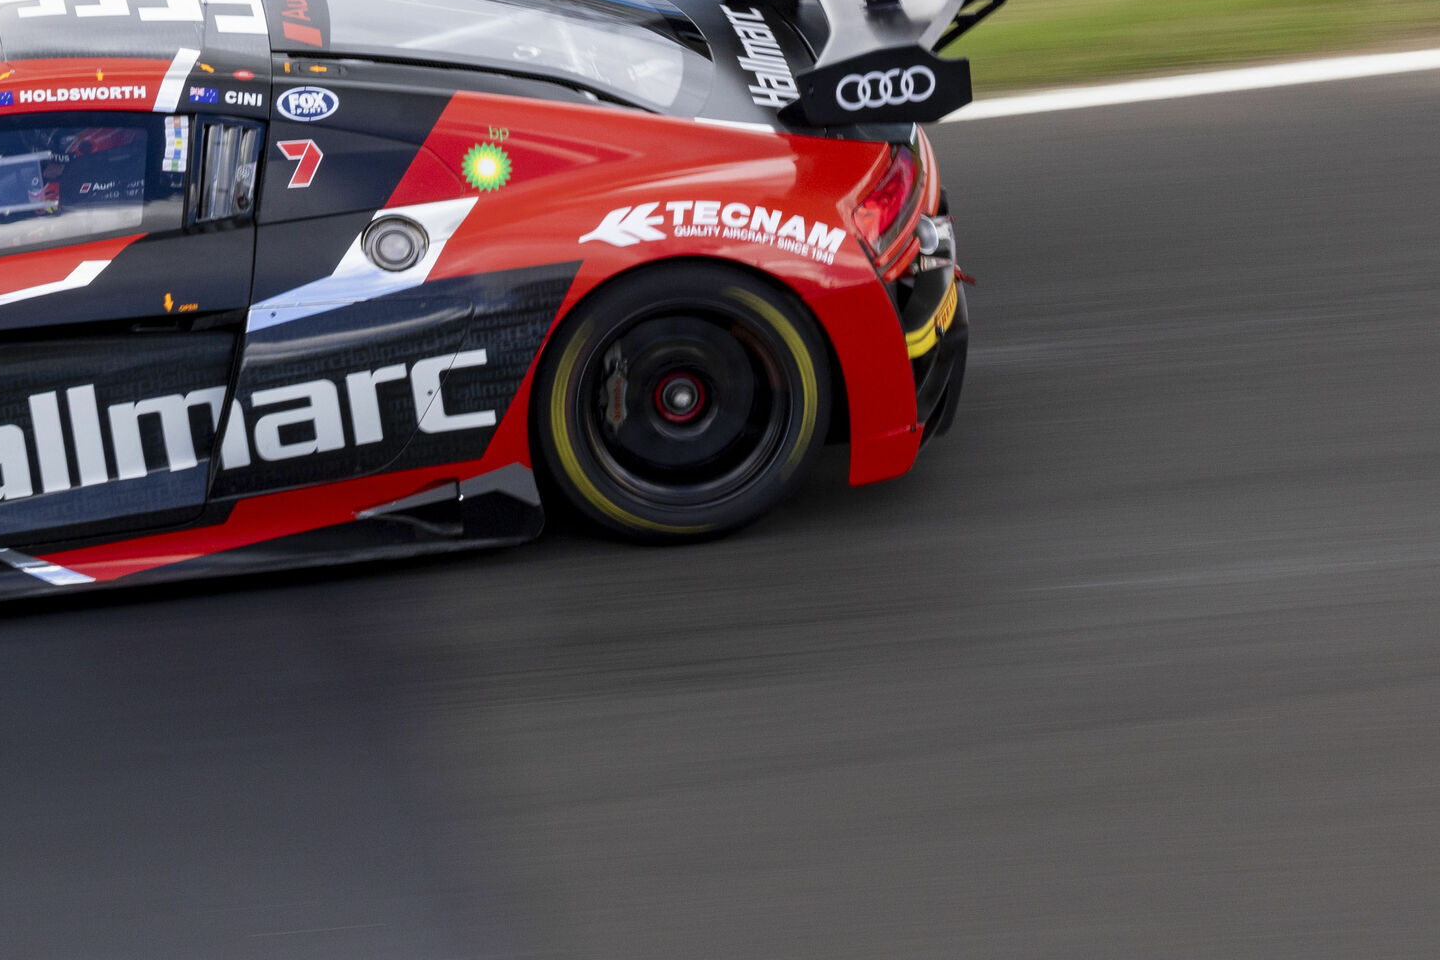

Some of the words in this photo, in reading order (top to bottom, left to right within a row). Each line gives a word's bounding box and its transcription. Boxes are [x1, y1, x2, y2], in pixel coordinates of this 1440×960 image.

[720, 4, 800, 108] Hallmarc
[19, 86, 146, 103] HOLDSWORTH
[225, 91, 262, 107] CINI
[288, 92, 327, 109] FOX
[291, 106, 327, 115] SPORTS
[488, 125, 509, 142] bp
[276, 139, 323, 188] 7
[666, 200, 846, 253] TECNAM
[674, 224, 720, 238] QUALITY
[722, 227, 775, 247] AIRCRAFT
[777, 237, 809, 256] SINCE
[811, 246, 835, 266] 1948
